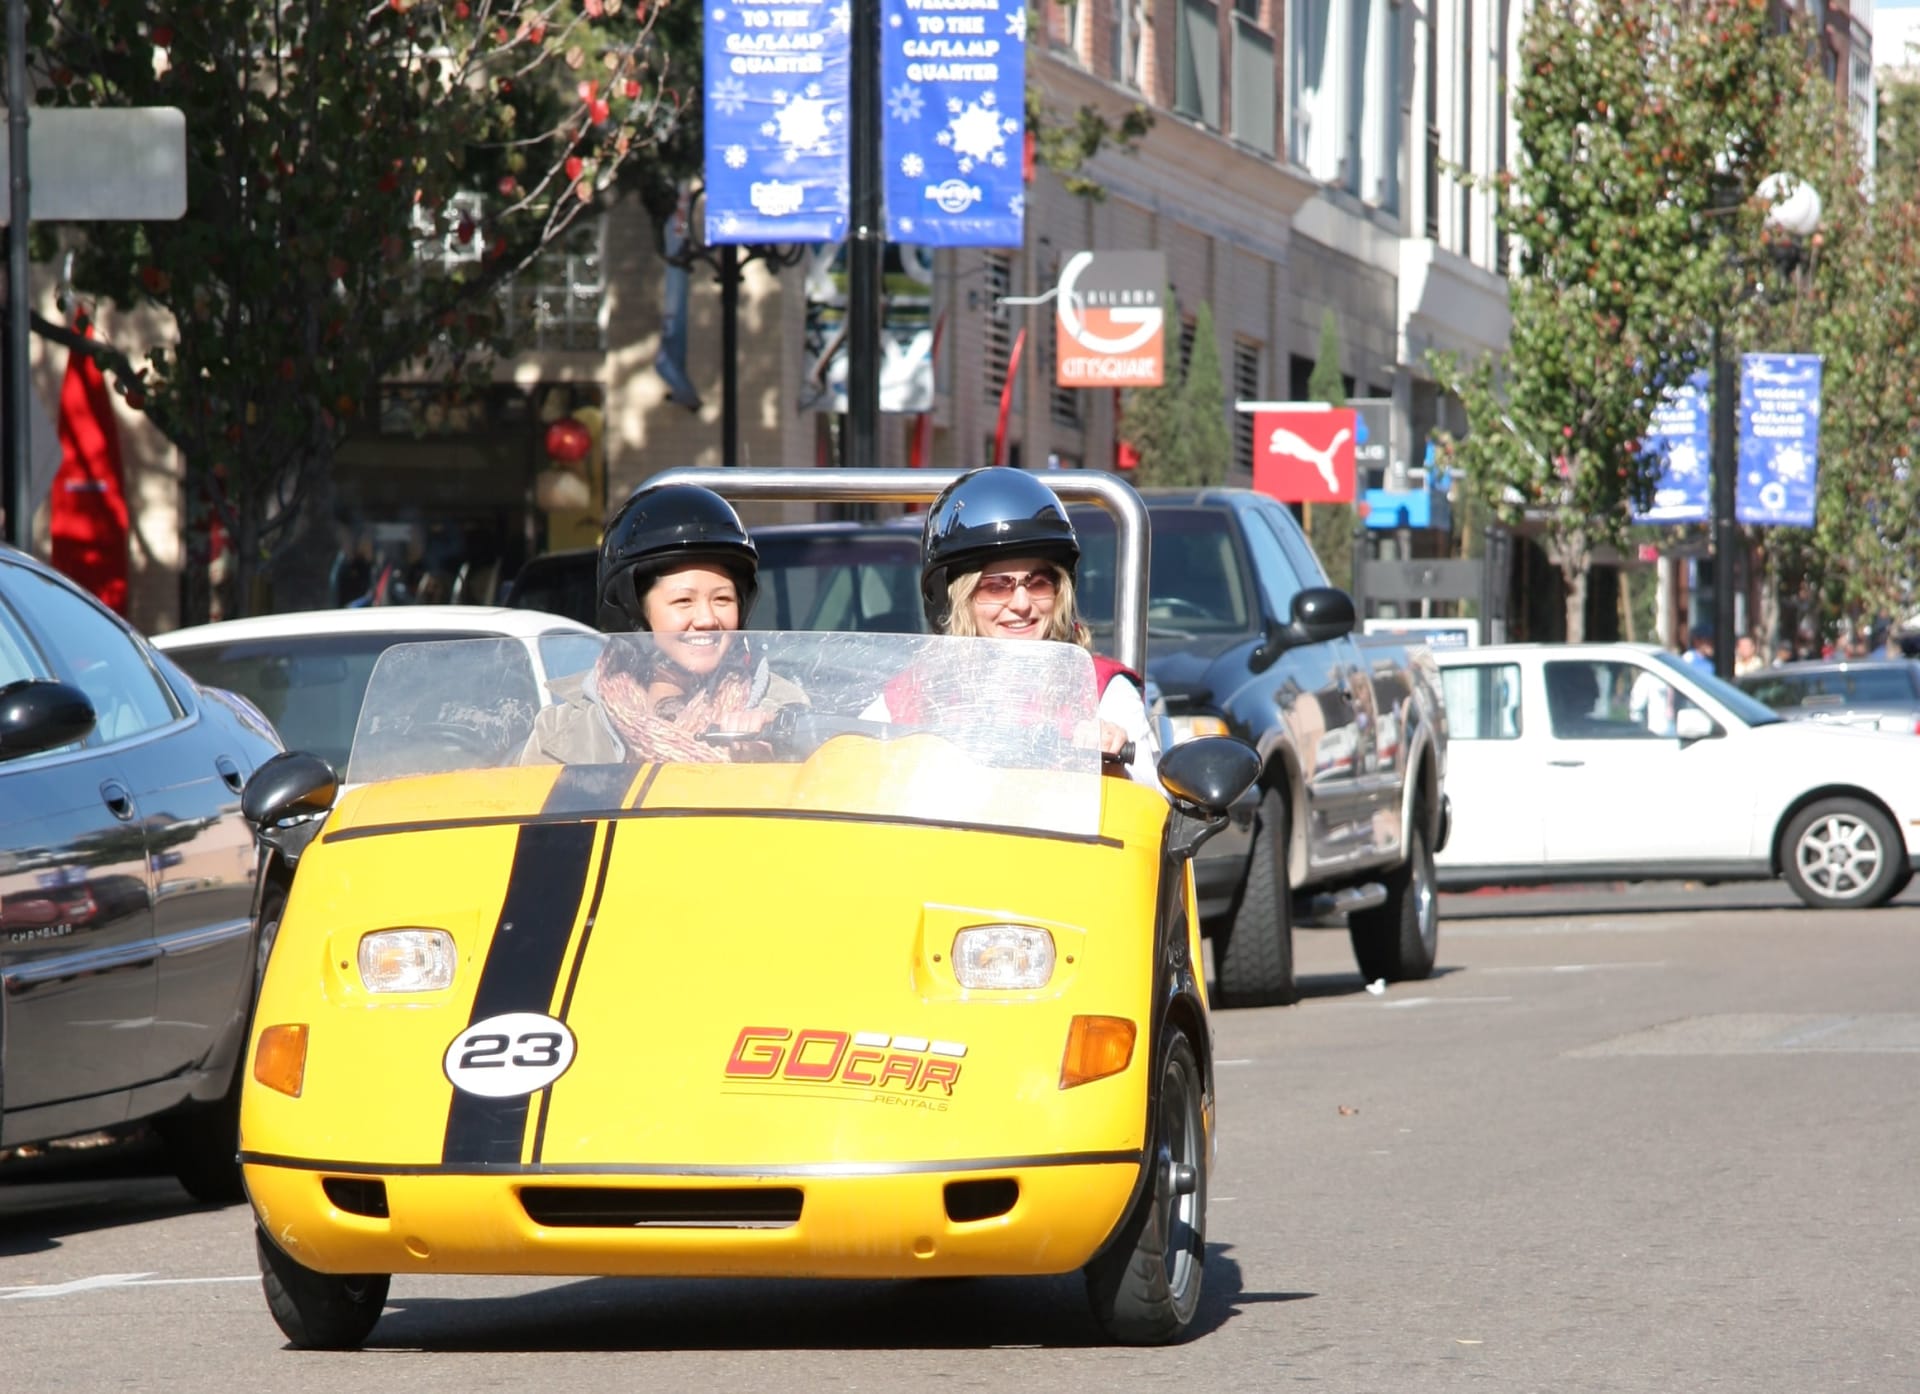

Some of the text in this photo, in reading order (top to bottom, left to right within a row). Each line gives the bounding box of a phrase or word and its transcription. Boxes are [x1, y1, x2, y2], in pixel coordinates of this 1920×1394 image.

[741, 9, 809, 27] TO THE
[917, 16, 984, 33] TO THE
[726, 33, 824, 51] GASLAMP
[903, 40, 1000, 57] GASLAMP
[730, 56, 823, 74] QUARTER
[907, 63, 998, 81] QUARTER
[11, 923, 72, 944] CHRYSLER
[459, 1032, 563, 1069] 23
[873, 1095, 949, 1112] RENTALS
